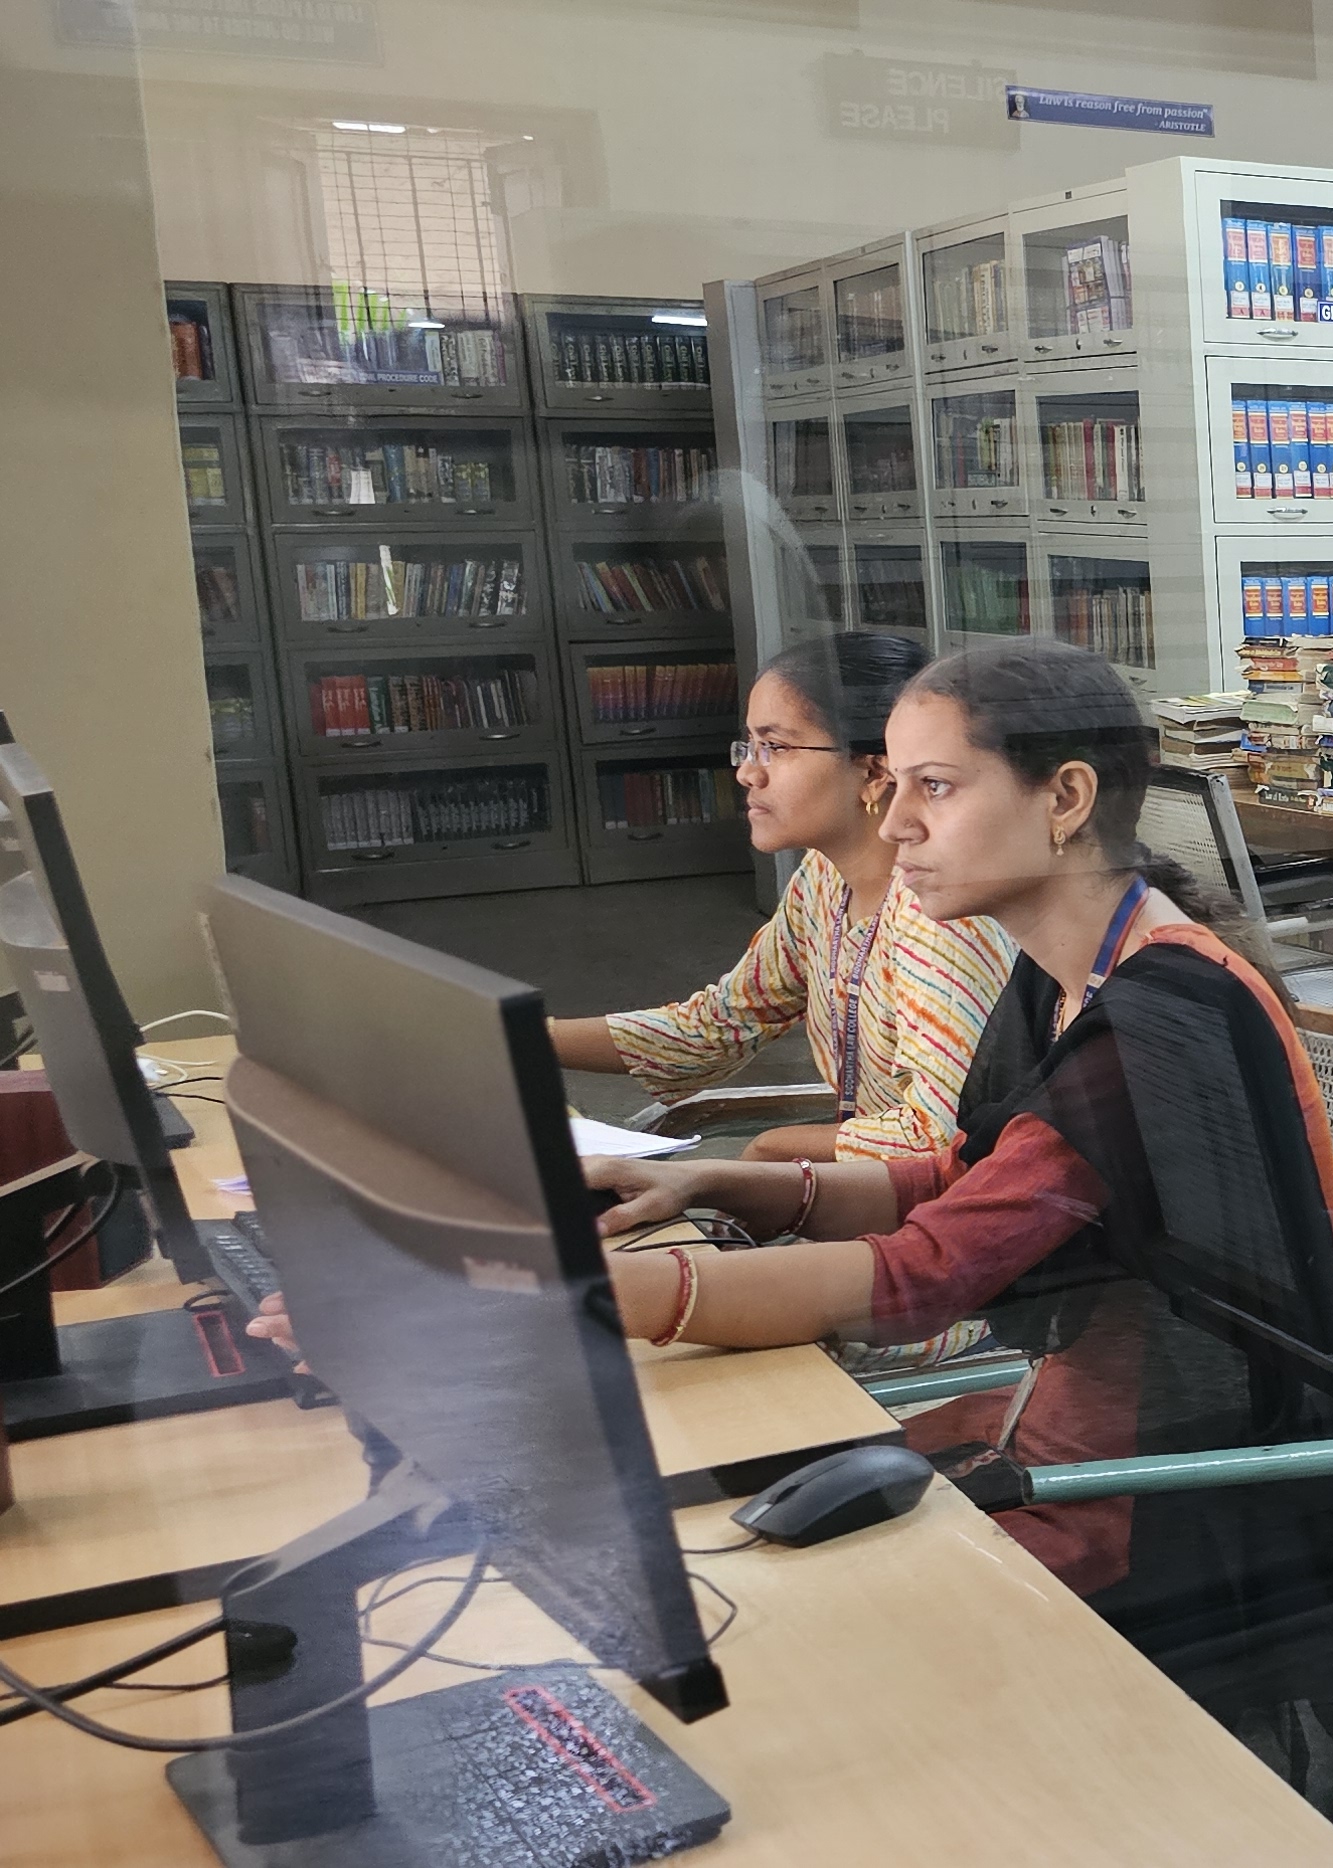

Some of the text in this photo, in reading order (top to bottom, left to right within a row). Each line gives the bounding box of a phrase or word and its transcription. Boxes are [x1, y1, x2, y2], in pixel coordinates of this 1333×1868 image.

[1075, 99, 1112, 111] reason
[1113, 99, 1136, 113] free
[1136, 103, 1163, 117] from
[1158, 121, 1207, 132] ARISTOTLE
[377, 373, 419, 383] PROCEDURE
[418, 374, 438, 384] CODE
